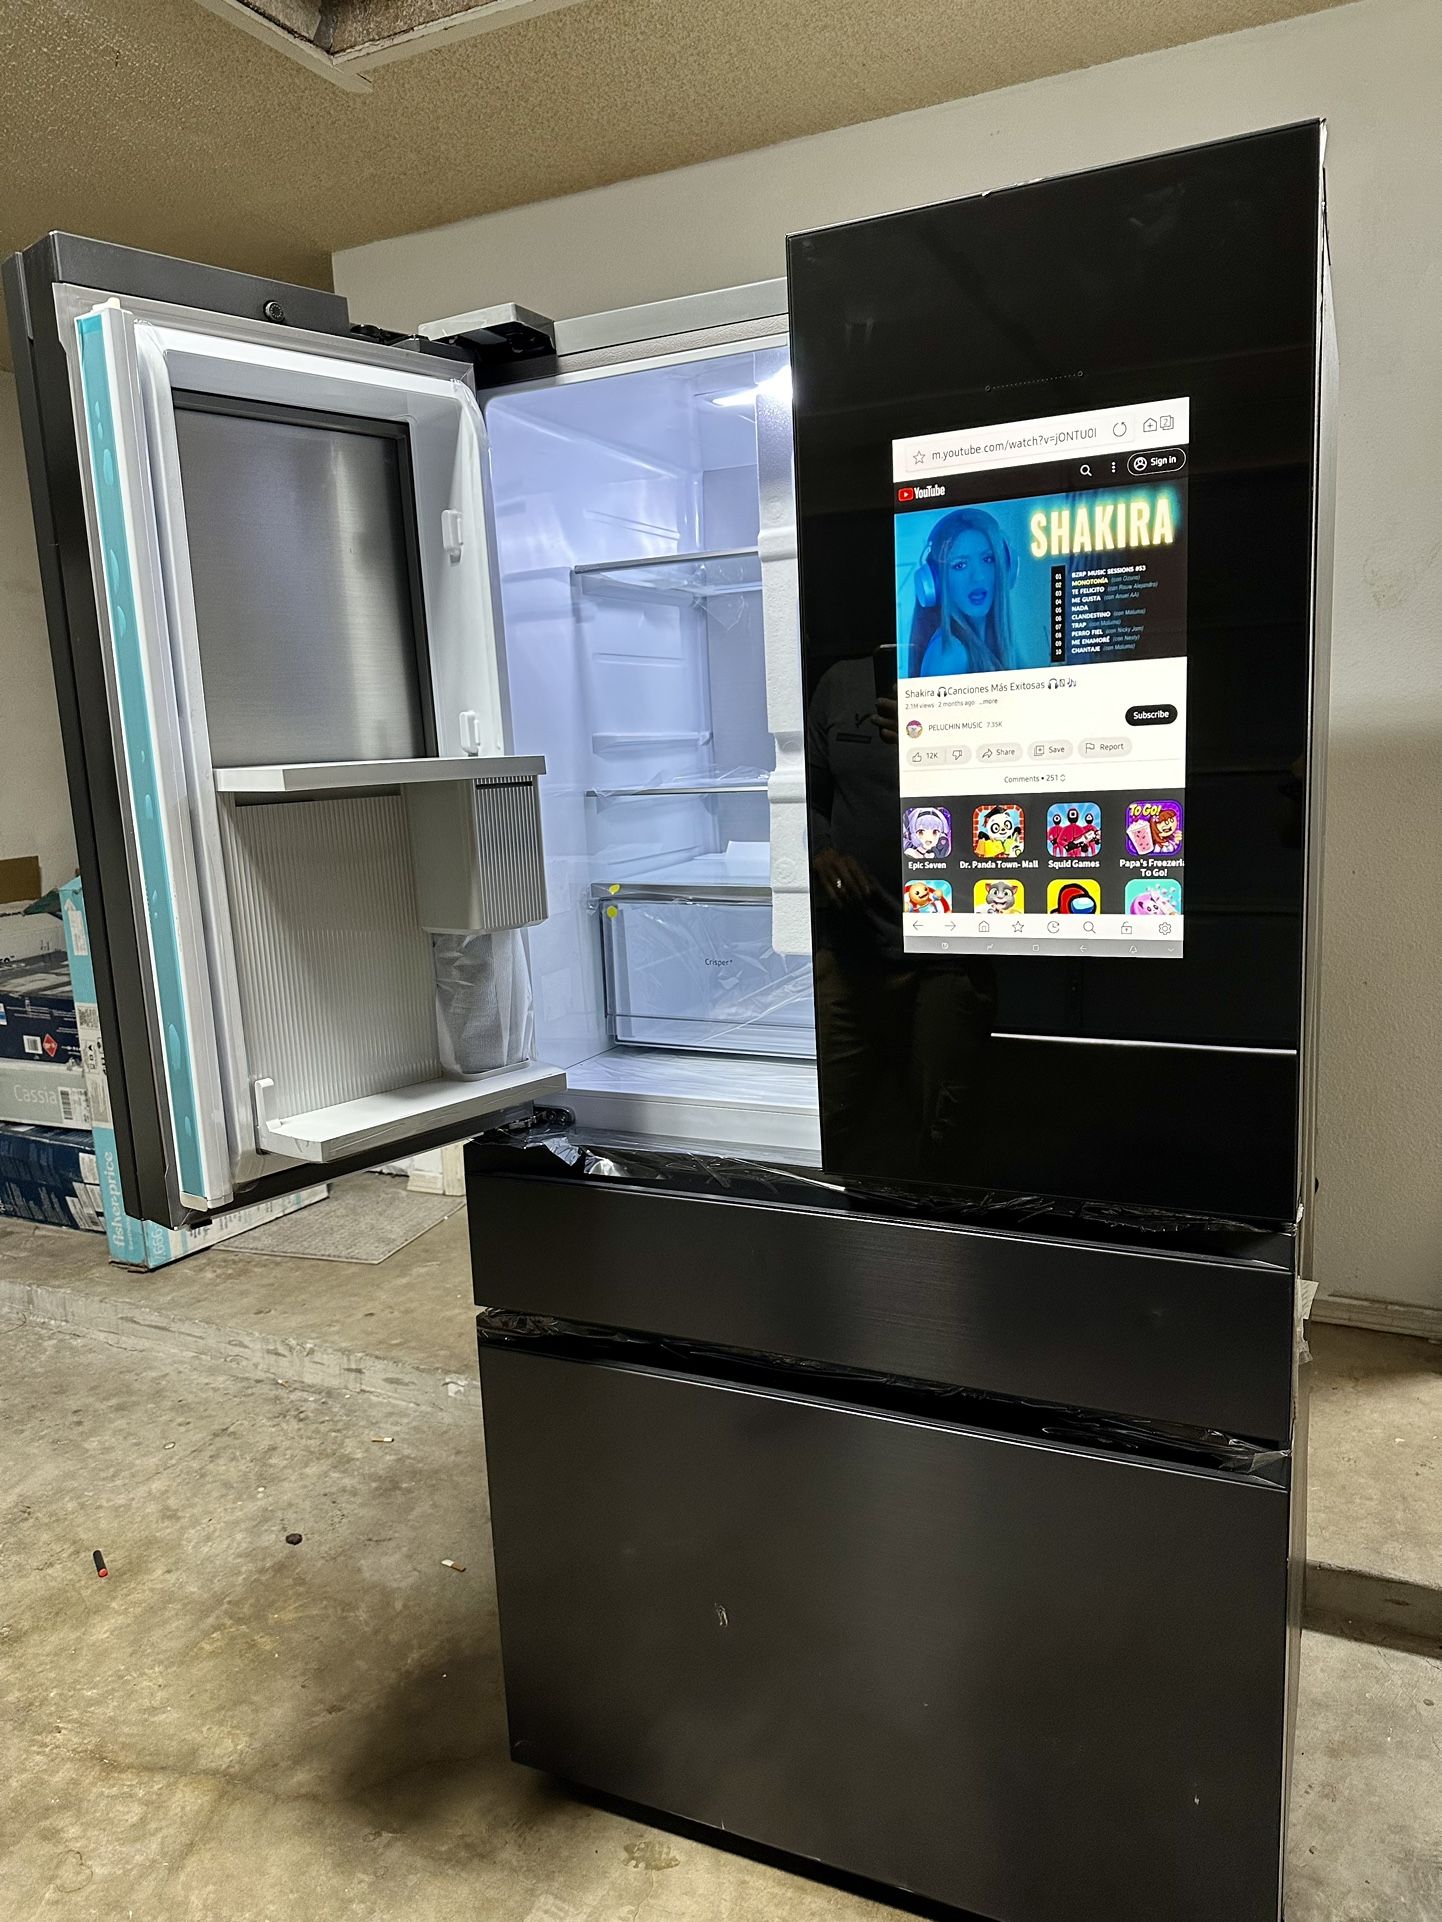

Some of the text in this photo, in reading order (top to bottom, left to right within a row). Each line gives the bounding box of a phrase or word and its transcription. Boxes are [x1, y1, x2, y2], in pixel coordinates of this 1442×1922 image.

[1150, 458, 1167, 467] Sign
[914, 484, 946, 498] YouTube
[1030, 498, 1173, 558] SHAKIRA
[1107, 567, 1134, 575] SESSIONS
[1072, 611, 1111, 620] CLANDESTINO
[905, 681, 1045, 698] Shakira Canciones Más Exitosas
[1133, 710, 1169, 719] Subscribe
[928, 723, 961, 732] PELUCHIN
[1048, 746, 1065, 754] Save
[1100, 743, 1124, 751] Report
[997, 748, 1015, 756] Share
[1004, 775, 1039, 783] Comments
[960, 861, 971, 869] Dr.
[972, 861, 996, 869] Panda
[1022, 860, 1039, 868] Mall
[1048, 860, 1100, 869] Squid Games
[1120, 859, 1147, 868] Papa's
[14, 1084, 57, 1105] Cassia
